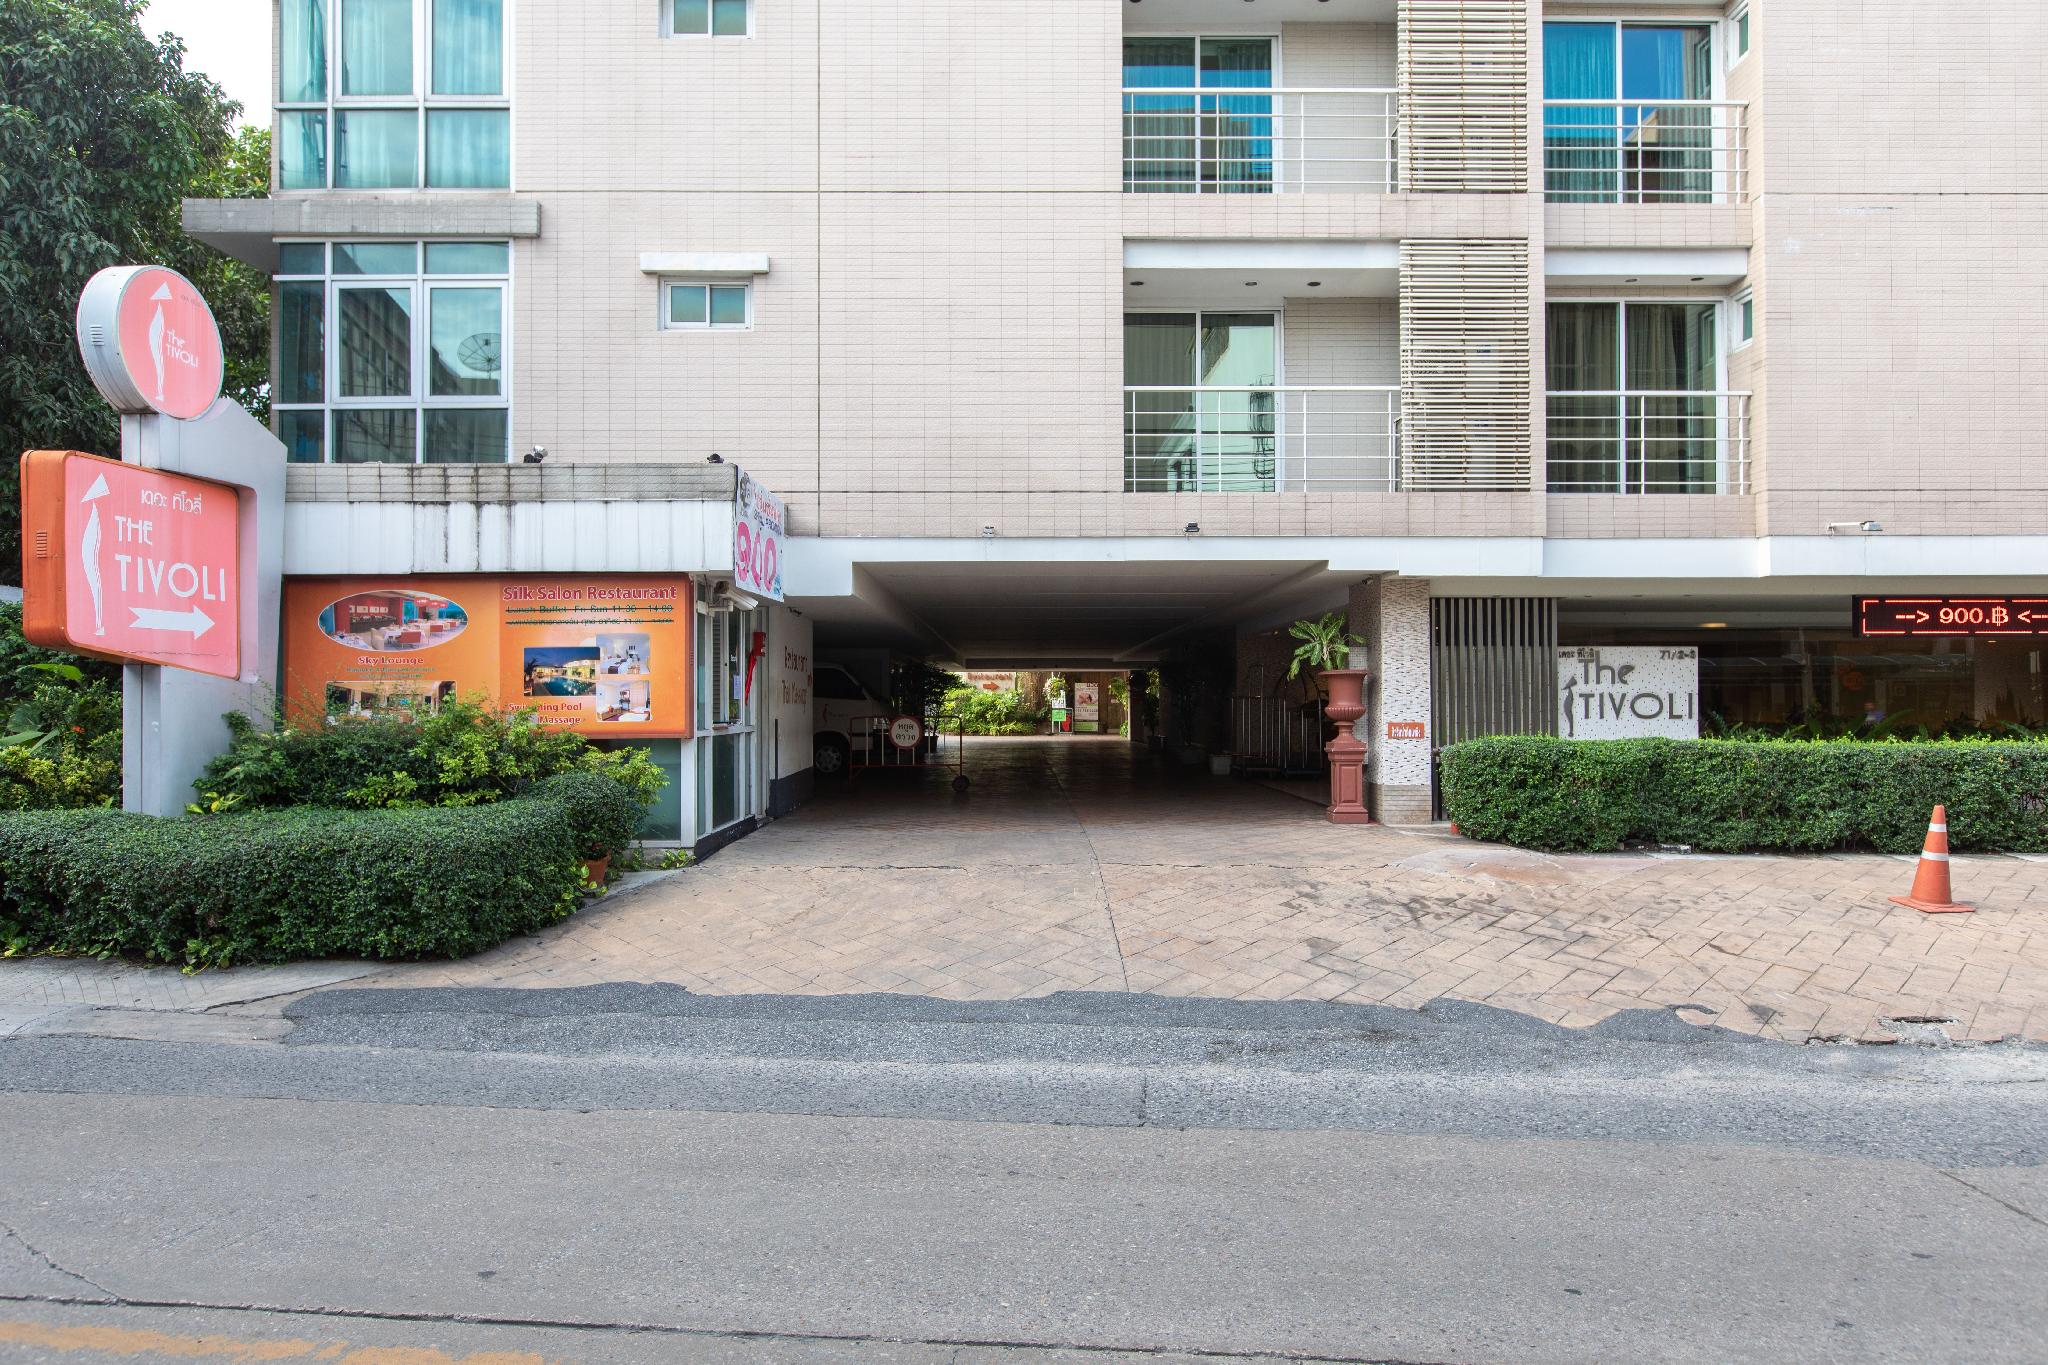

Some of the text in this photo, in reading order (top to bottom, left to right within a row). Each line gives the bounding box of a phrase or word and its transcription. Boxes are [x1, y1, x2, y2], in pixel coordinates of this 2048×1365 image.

[166, 343, 199, 368] TIVOLI
[736, 521, 777, 593] 900
[115, 553, 226, 602] TIVOLI
[503, 586, 677, 600] Silk Salon Restaurant
[358, 655, 424, 665] Sky Lounge
[1578, 650, 1635, 685] The
[561, 703, 582, 711] Pool
[1579, 693, 1693, 719] TIVOLI
[538, 716, 581, 726] Massage
